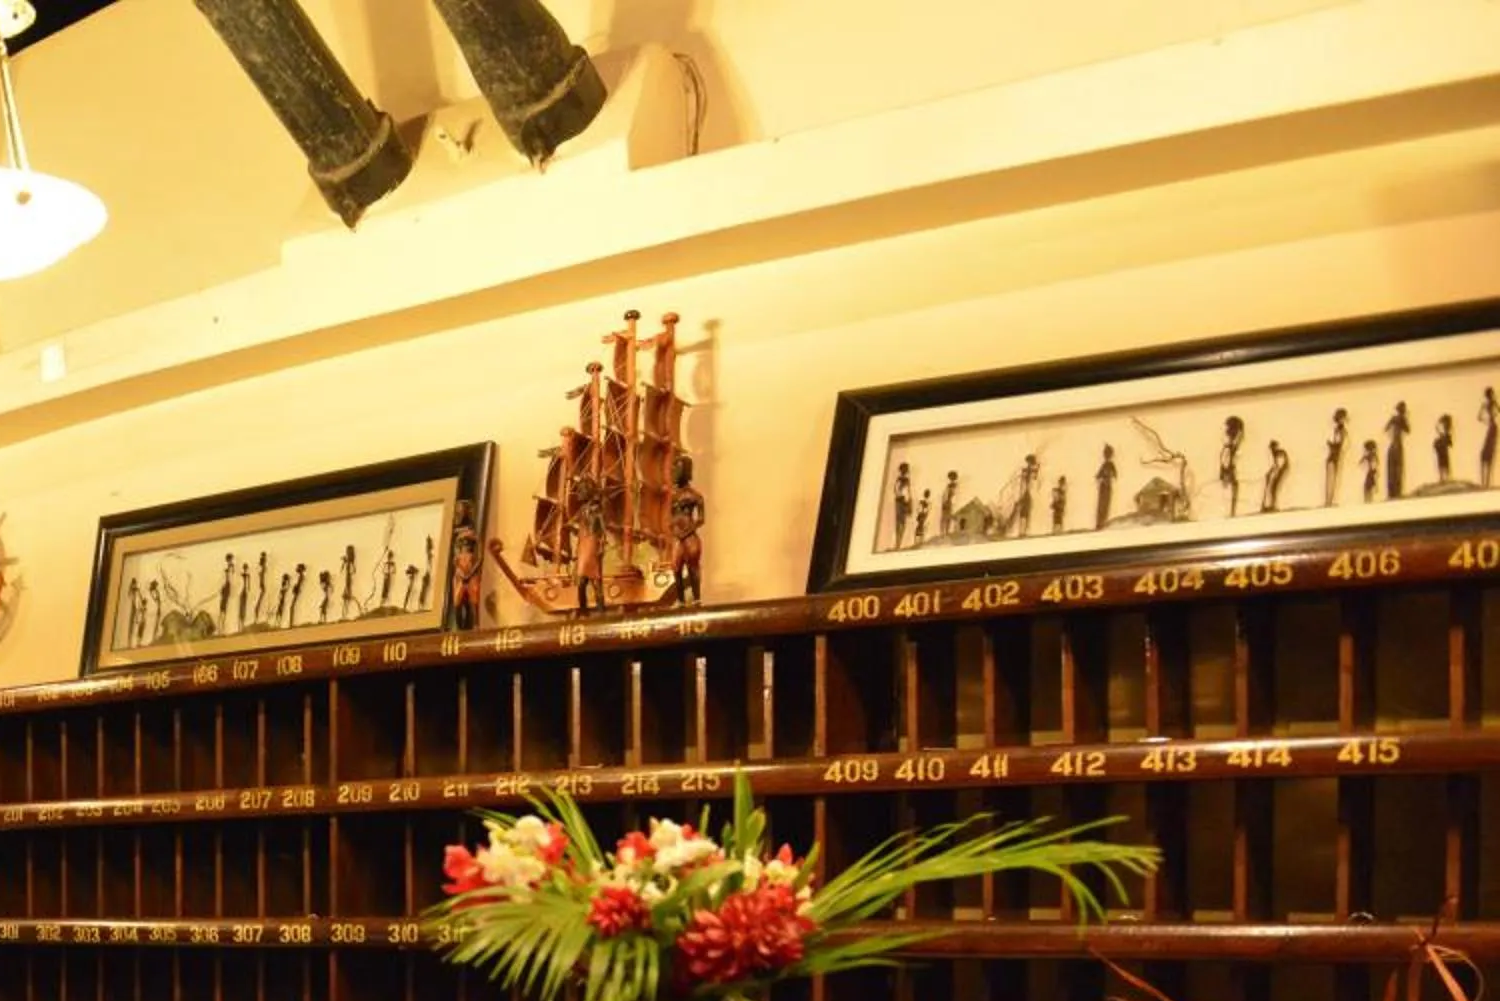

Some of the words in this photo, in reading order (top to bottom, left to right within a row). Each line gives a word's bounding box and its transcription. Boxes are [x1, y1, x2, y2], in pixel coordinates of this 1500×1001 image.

[827, 595, 880, 623] 400
[893, 590, 941, 618] 401
[961, 580, 1020, 612] 402
[1040, 574, 1104, 603] 403
[1133, 566, 1205, 596] 404
[1224, 558, 1293, 589] 405
[1328, 548, 1401, 580] 406
[1448, 540, 1500, 570] 40
[232, 658, 259, 680] 107
[276, 654, 303, 676] 108
[333, 646, 361, 667] 109
[382, 642, 407, 662] 110
[441, 635, 459, 656] 111
[496, 629, 524, 652] 112
[559, 624, 587, 647] 113
[823, 758, 880, 784] 409
[894, 757, 945, 782] 410
[969, 752, 1010, 780] 411
[1051, 750, 1107, 778] 412
[1140, 746, 1197, 773] 413
[1226, 741, 1292, 768] 414
[1337, 736, 1400, 765] 415
[240, 790, 272, 810] 207
[282, 788, 316, 808] 208
[337, 784, 372, 804] 209
[388, 782, 420, 802] 210
[443, 779, 468, 798] 211
[496, 774, 530, 796] 212
[555, 774, 593, 795] 213
[621, 772, 660, 795] 214
[681, 772, 722, 792] 215
[190, 926, 220, 943] 306
[232, 924, 264, 943] 307
[278, 924, 312, 943] 308
[331, 922, 366, 943] 309
[388, 922, 418, 943] 310
